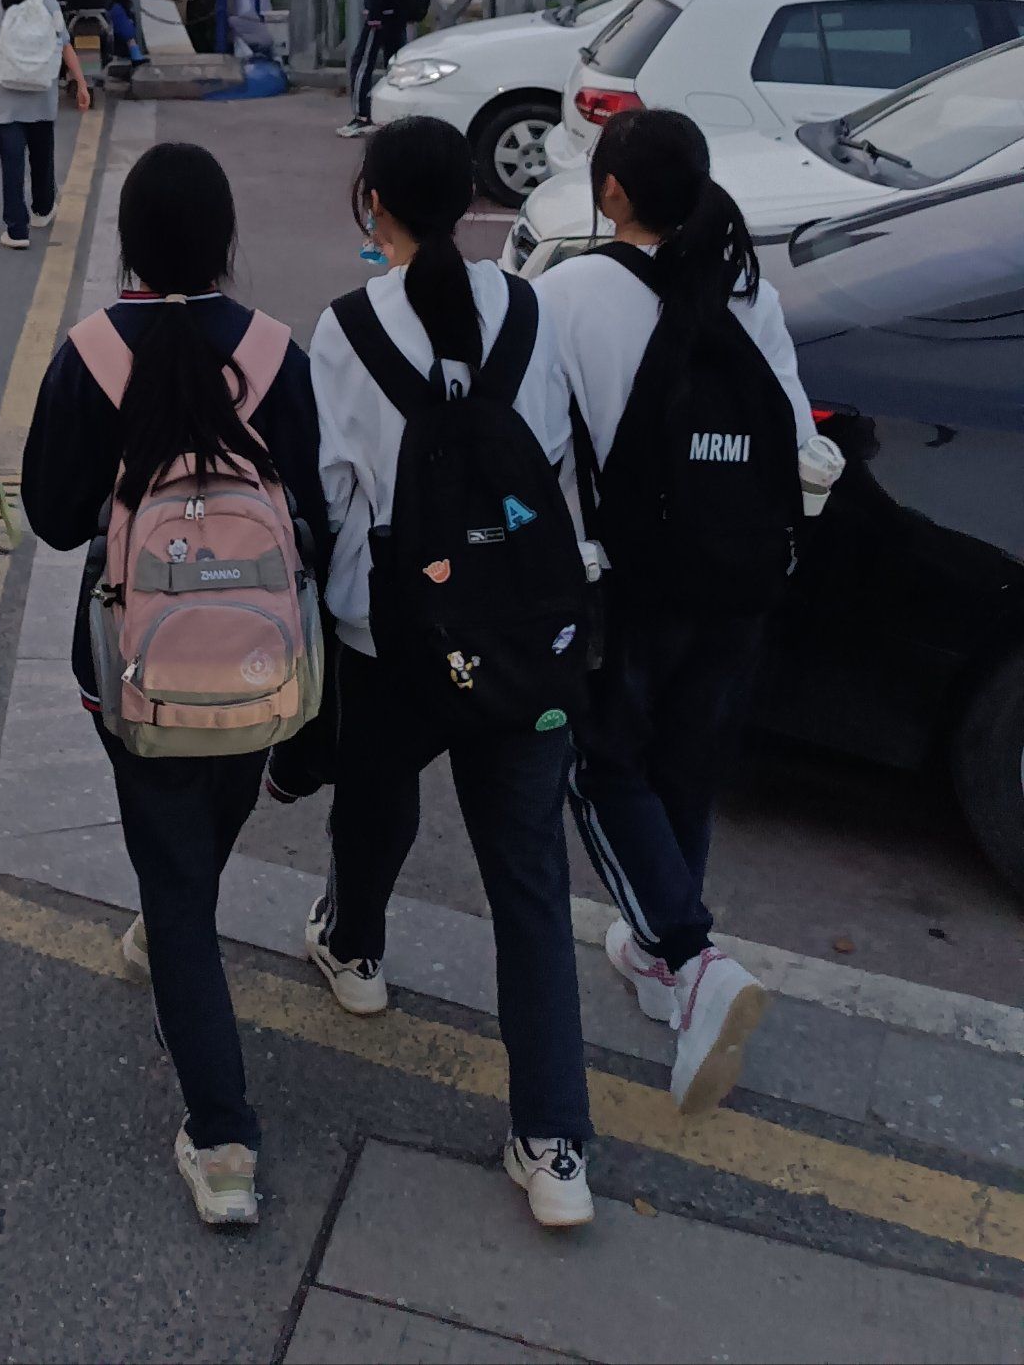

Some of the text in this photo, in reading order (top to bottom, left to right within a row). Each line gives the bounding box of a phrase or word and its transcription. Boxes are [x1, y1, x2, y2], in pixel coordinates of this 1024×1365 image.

[689, 432, 751, 463] MRMI
[504, 496, 535, 530] A
[200, 568, 241, 581] ZHANAO
